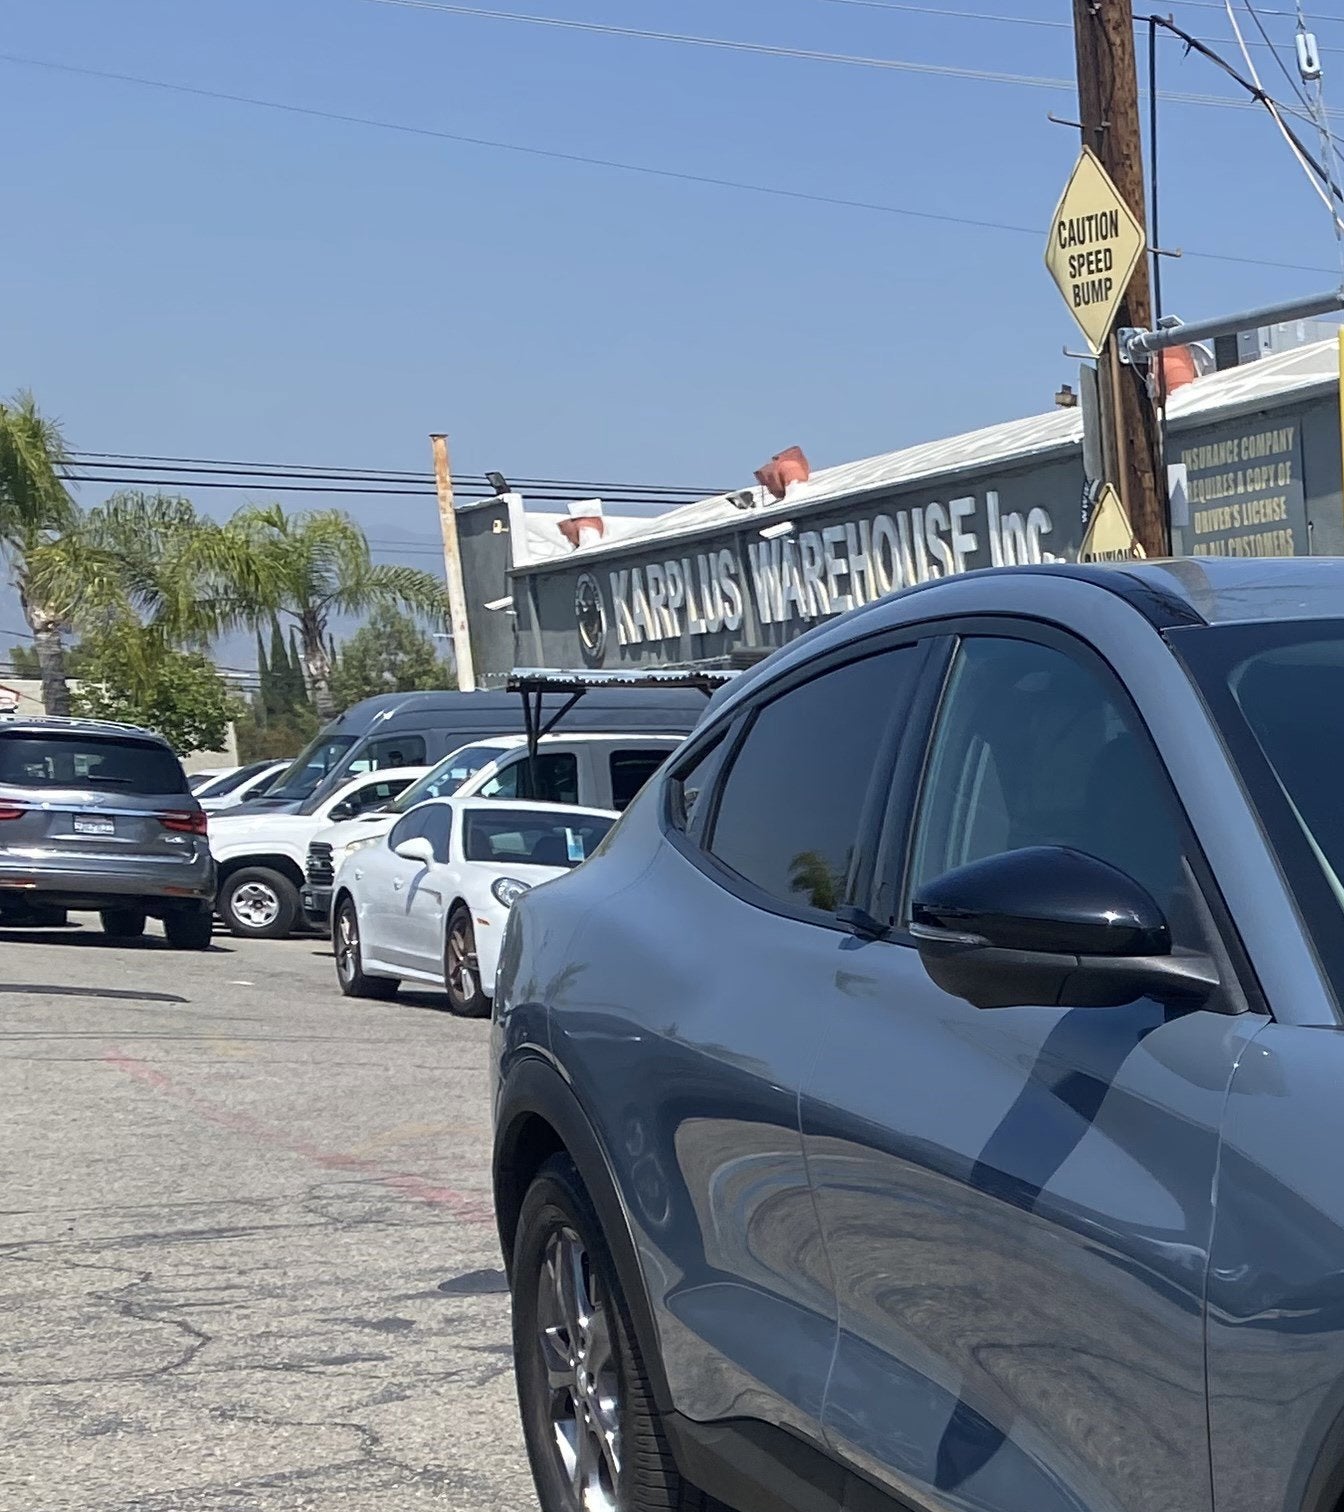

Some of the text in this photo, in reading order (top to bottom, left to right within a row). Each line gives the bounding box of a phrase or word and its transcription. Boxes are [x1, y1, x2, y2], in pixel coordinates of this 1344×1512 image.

[1057, 209, 1119, 249] CAUTION
[1068, 248, 1113, 279] SPEED
[1072, 277, 1113, 308] BUMP
[1181, 427, 1294, 471] INSURANCE COMPANY
[1187, 461, 1292, 503] REQUIRES A COPY OF
[1194, 496, 1288, 534] DRIVER'S LICENSE
[609, 548, 743, 646] KARPLUS
[748, 496, 979, 625] WAREHOUSE
